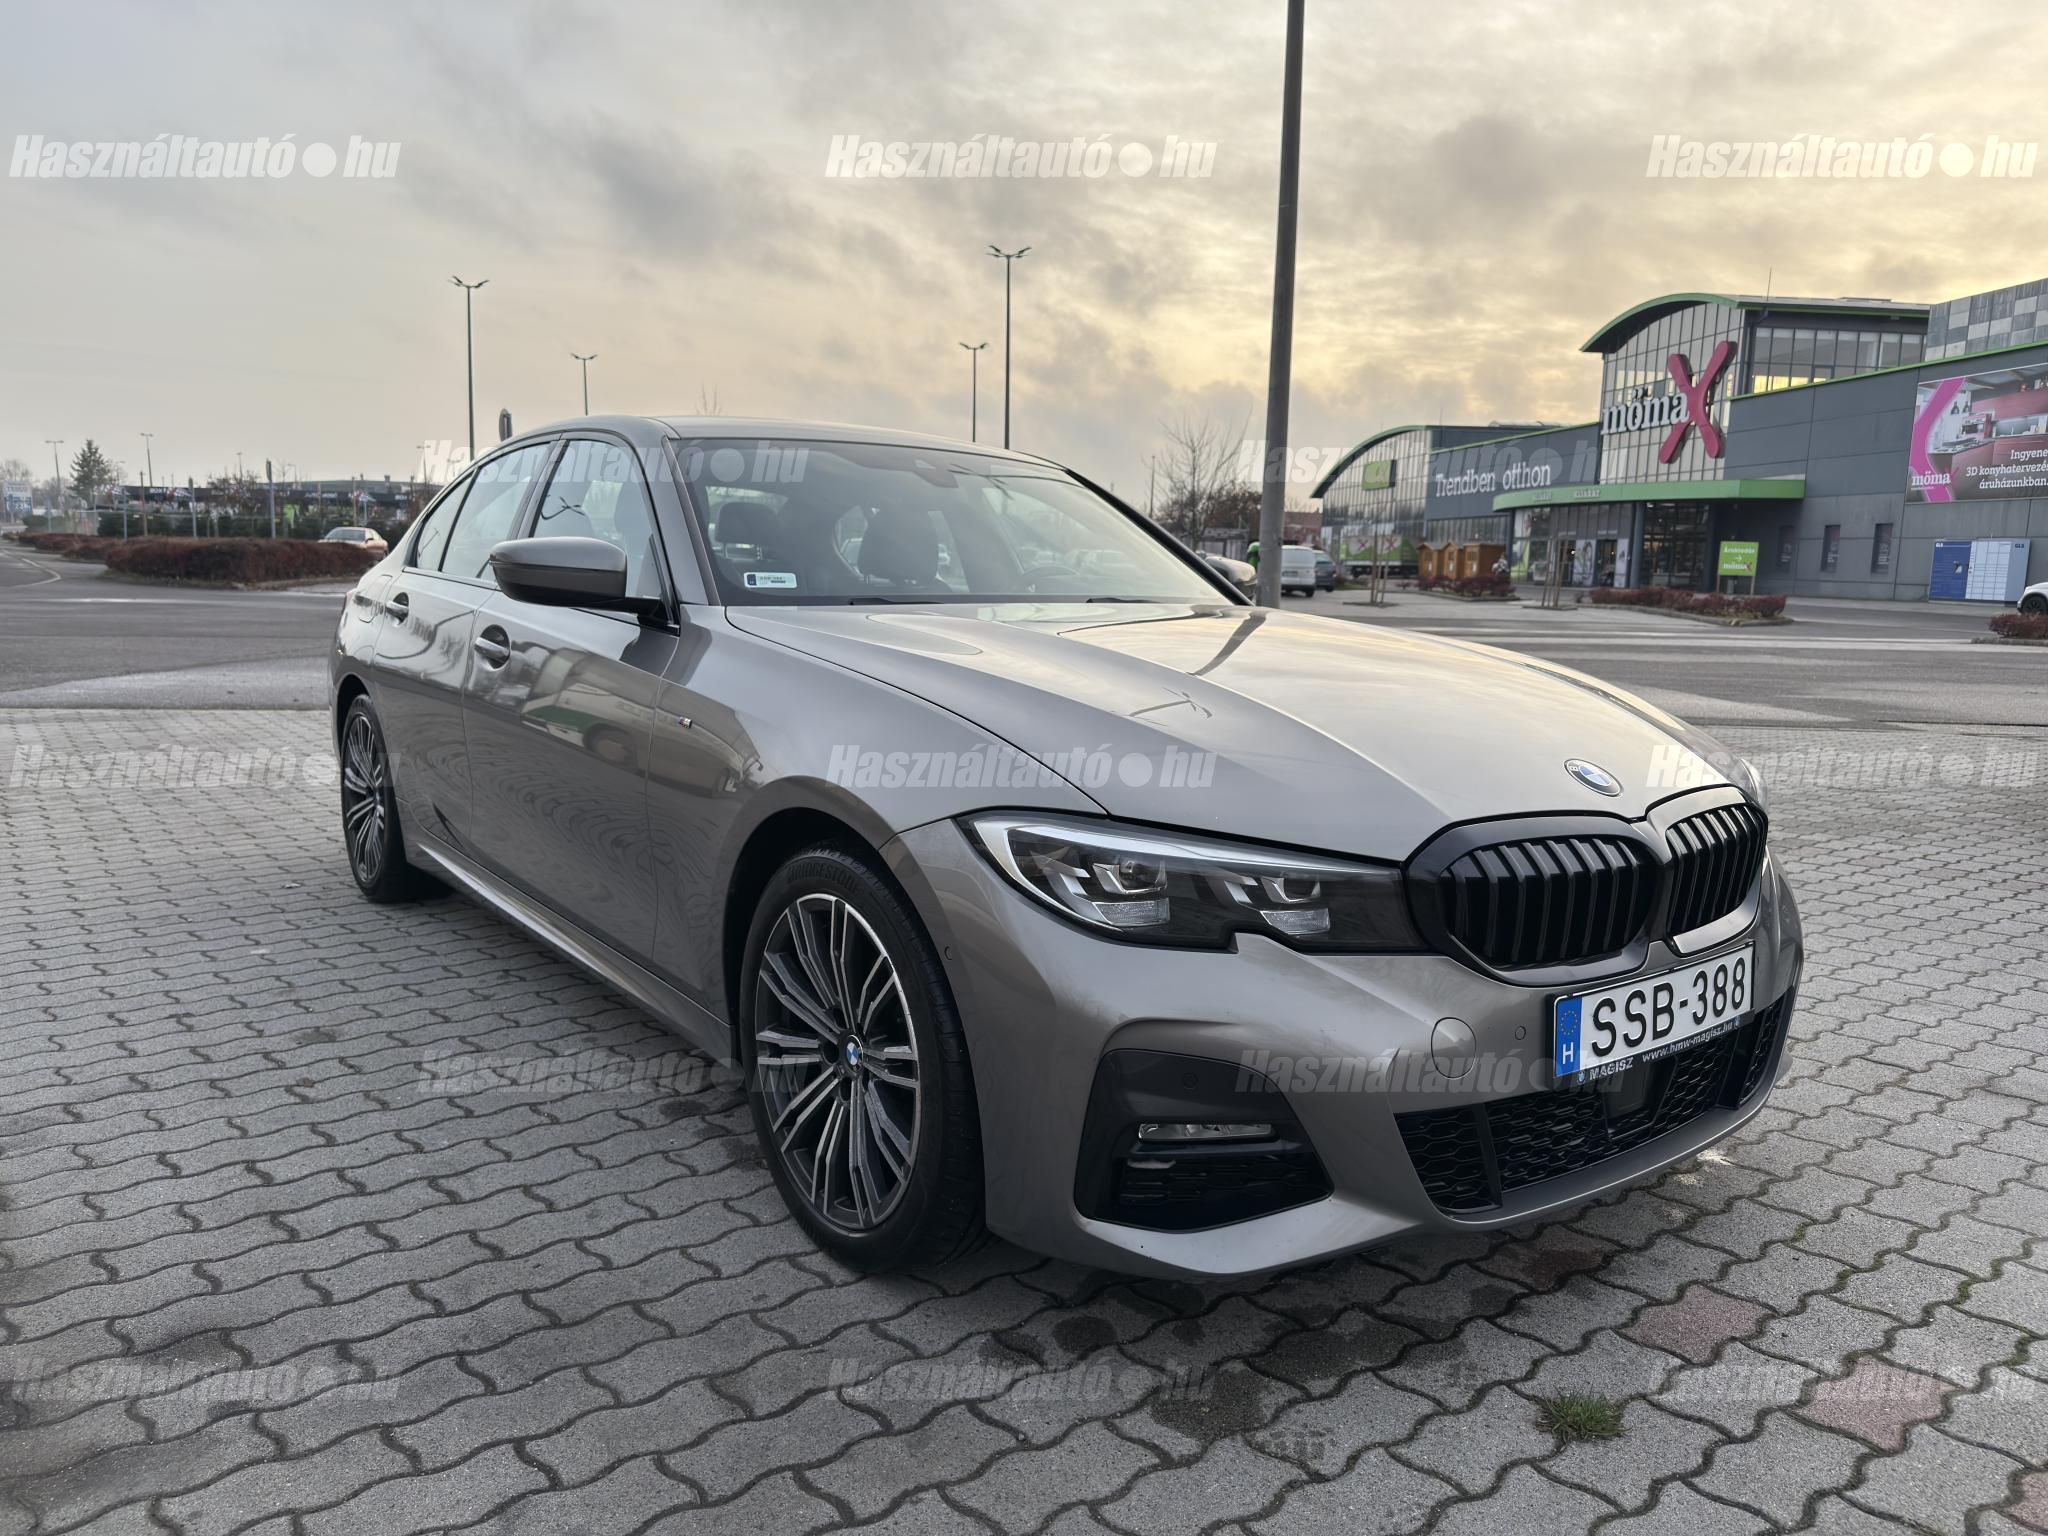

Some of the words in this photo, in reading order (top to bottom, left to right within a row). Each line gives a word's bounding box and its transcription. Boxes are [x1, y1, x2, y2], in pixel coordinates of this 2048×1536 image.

[1435, 469, 1495, 497] Trendben
[1502, 461, 1551, 490] otthon
[1966, 466, 1977, 477] 3D
[1591, 957, 1746, 1057] SSB-388
[1562, 1041, 1574, 1065] H
[1589, 1057, 1633, 1081] MAGISZ
[1642, 1020, 1733, 1063] www.bmw-magisz.hu
